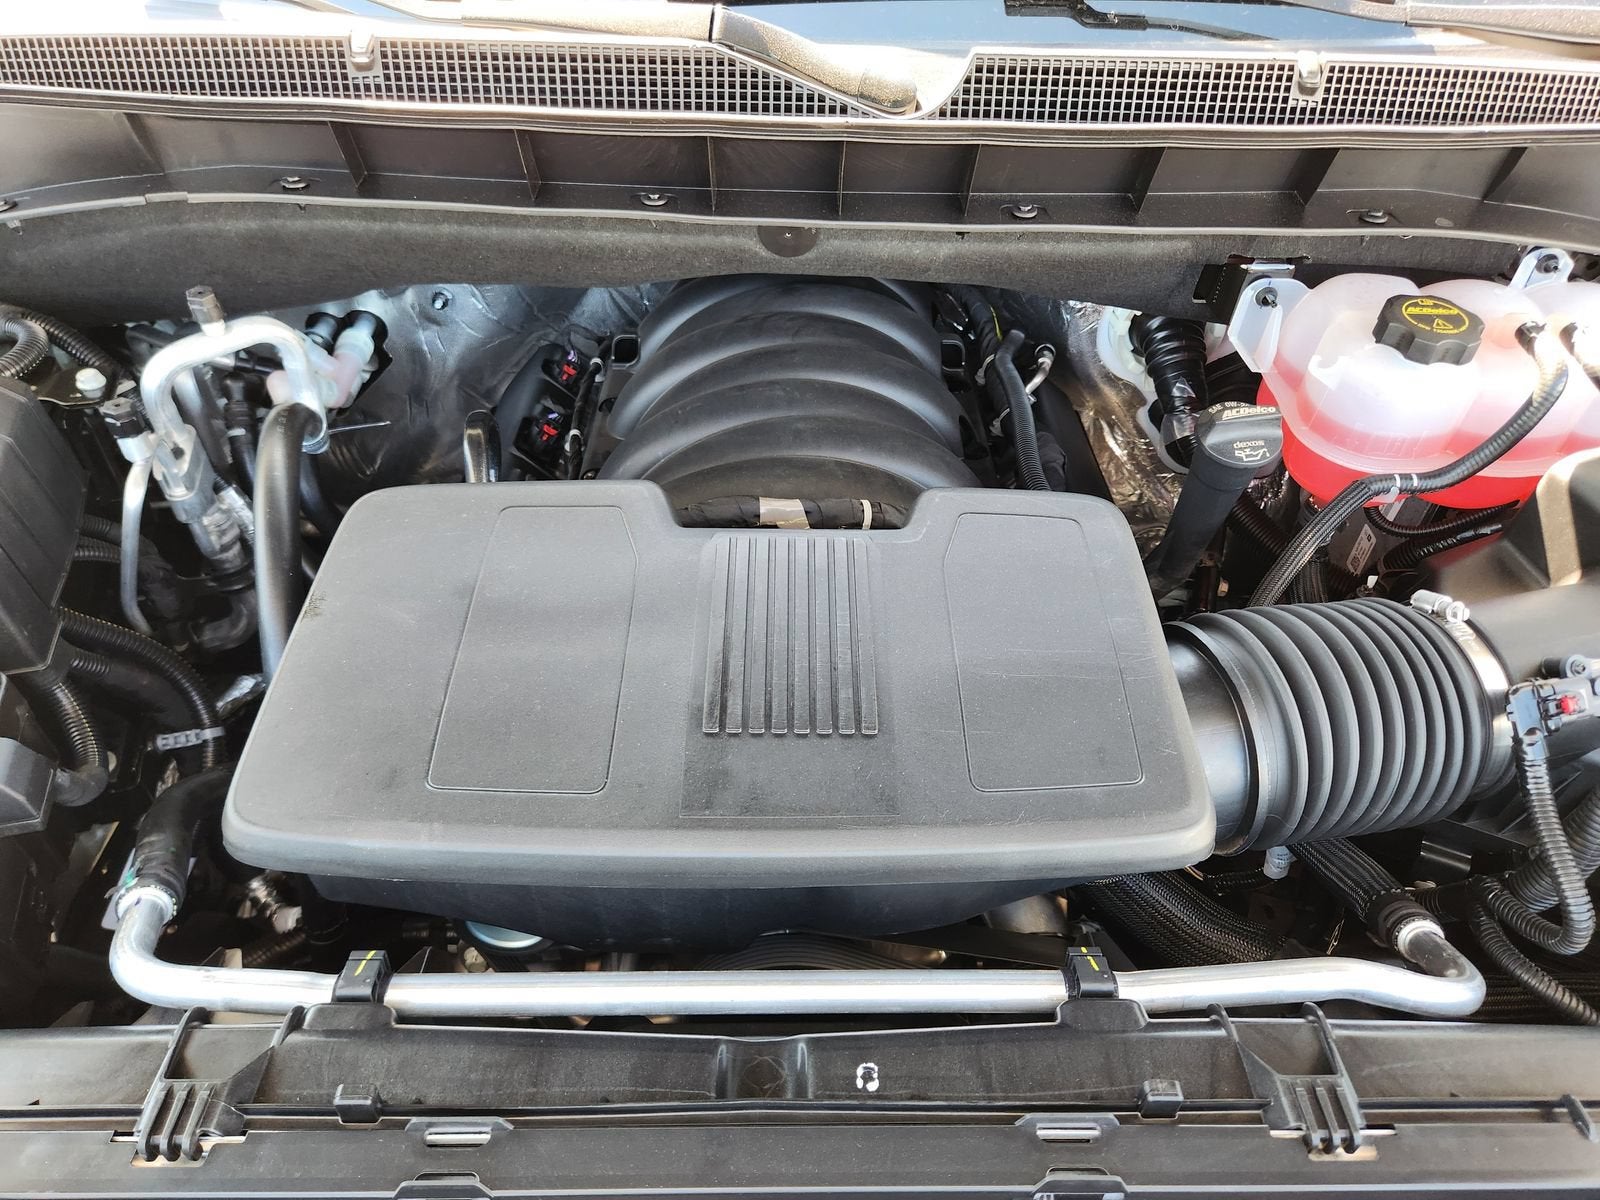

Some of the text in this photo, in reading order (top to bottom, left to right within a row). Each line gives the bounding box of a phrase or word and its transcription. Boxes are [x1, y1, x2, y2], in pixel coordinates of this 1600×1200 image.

[1405, 306, 1459, 314] ACDelco
[1208, 403, 1223, 414] SAE
[1222, 406, 1276, 418] ACDelco
[1233, 440, 1264, 449] dexos
